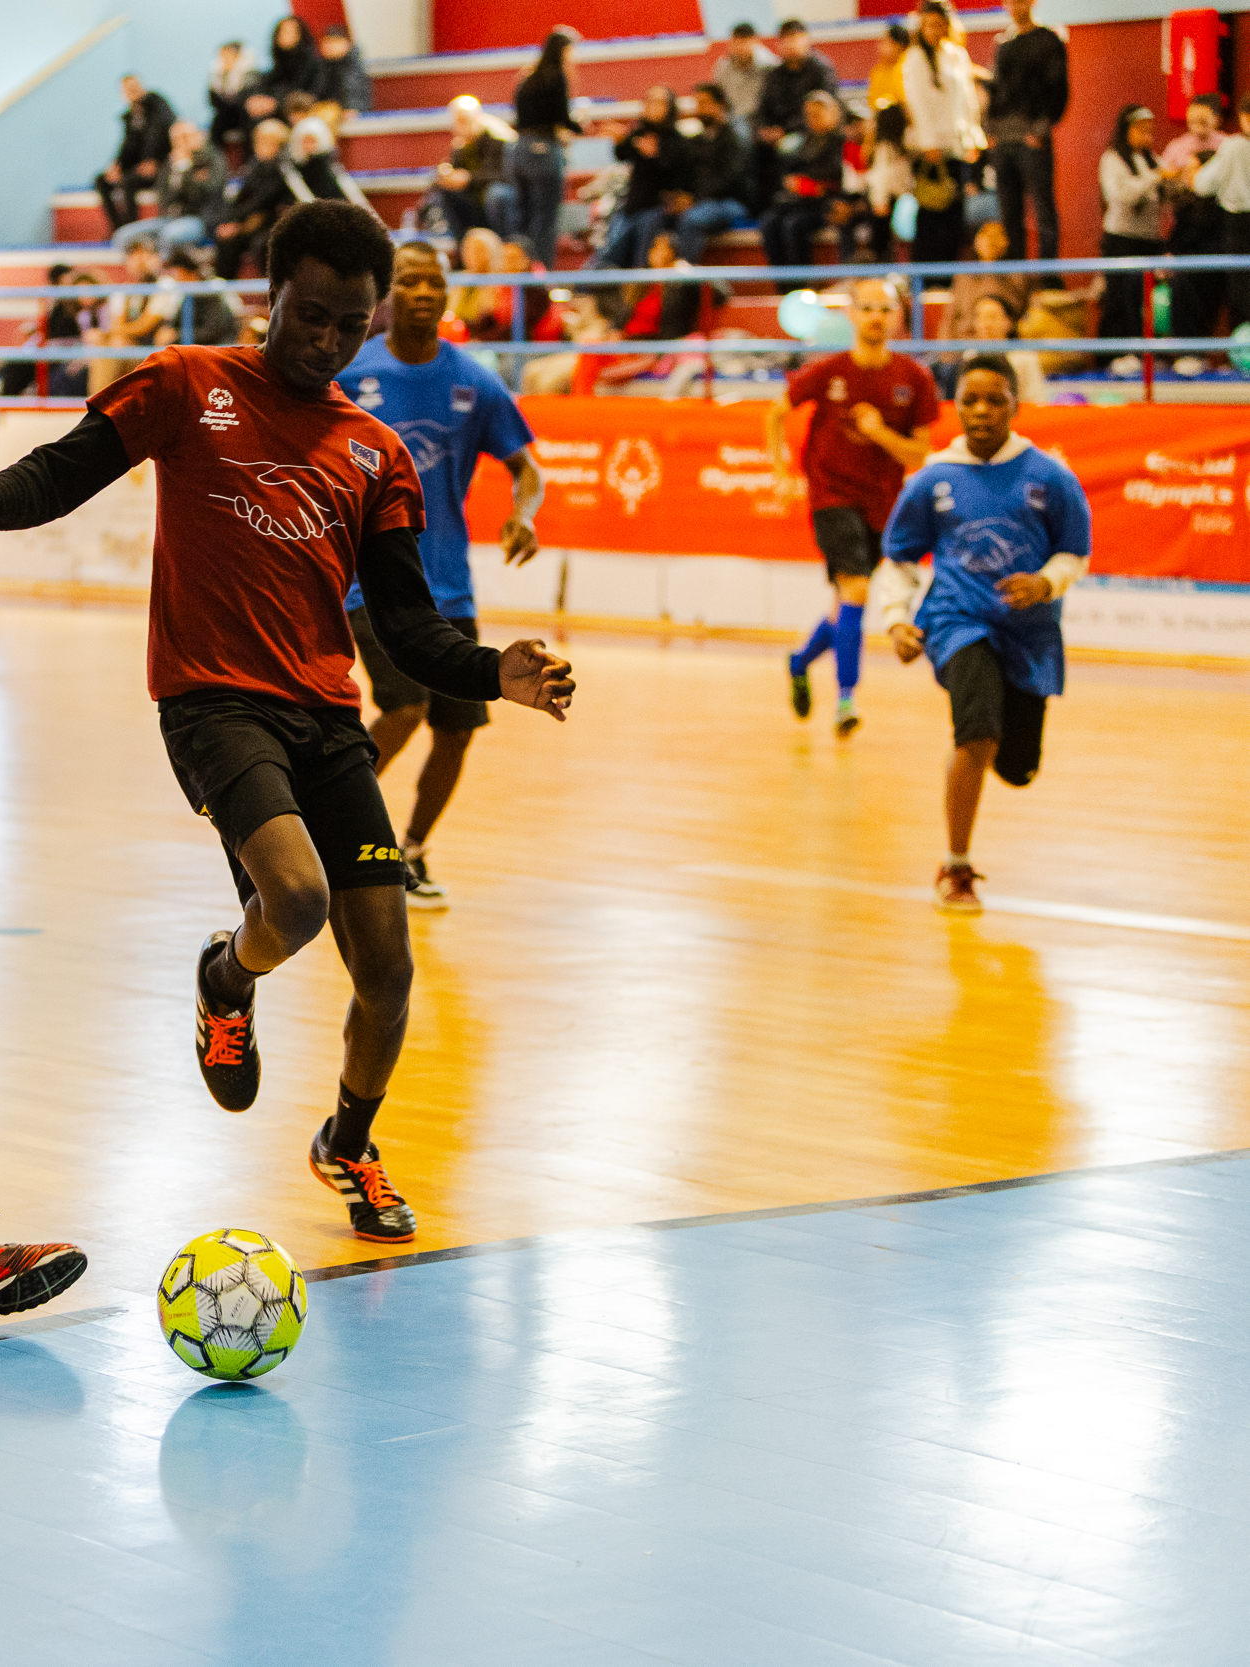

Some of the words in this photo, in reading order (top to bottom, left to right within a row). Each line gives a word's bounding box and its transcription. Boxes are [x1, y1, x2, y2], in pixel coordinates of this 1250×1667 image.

[203, 409, 237, 418] Special
[199, 417, 240, 425] Olympics
[356, 843, 402, 862] Zeu
